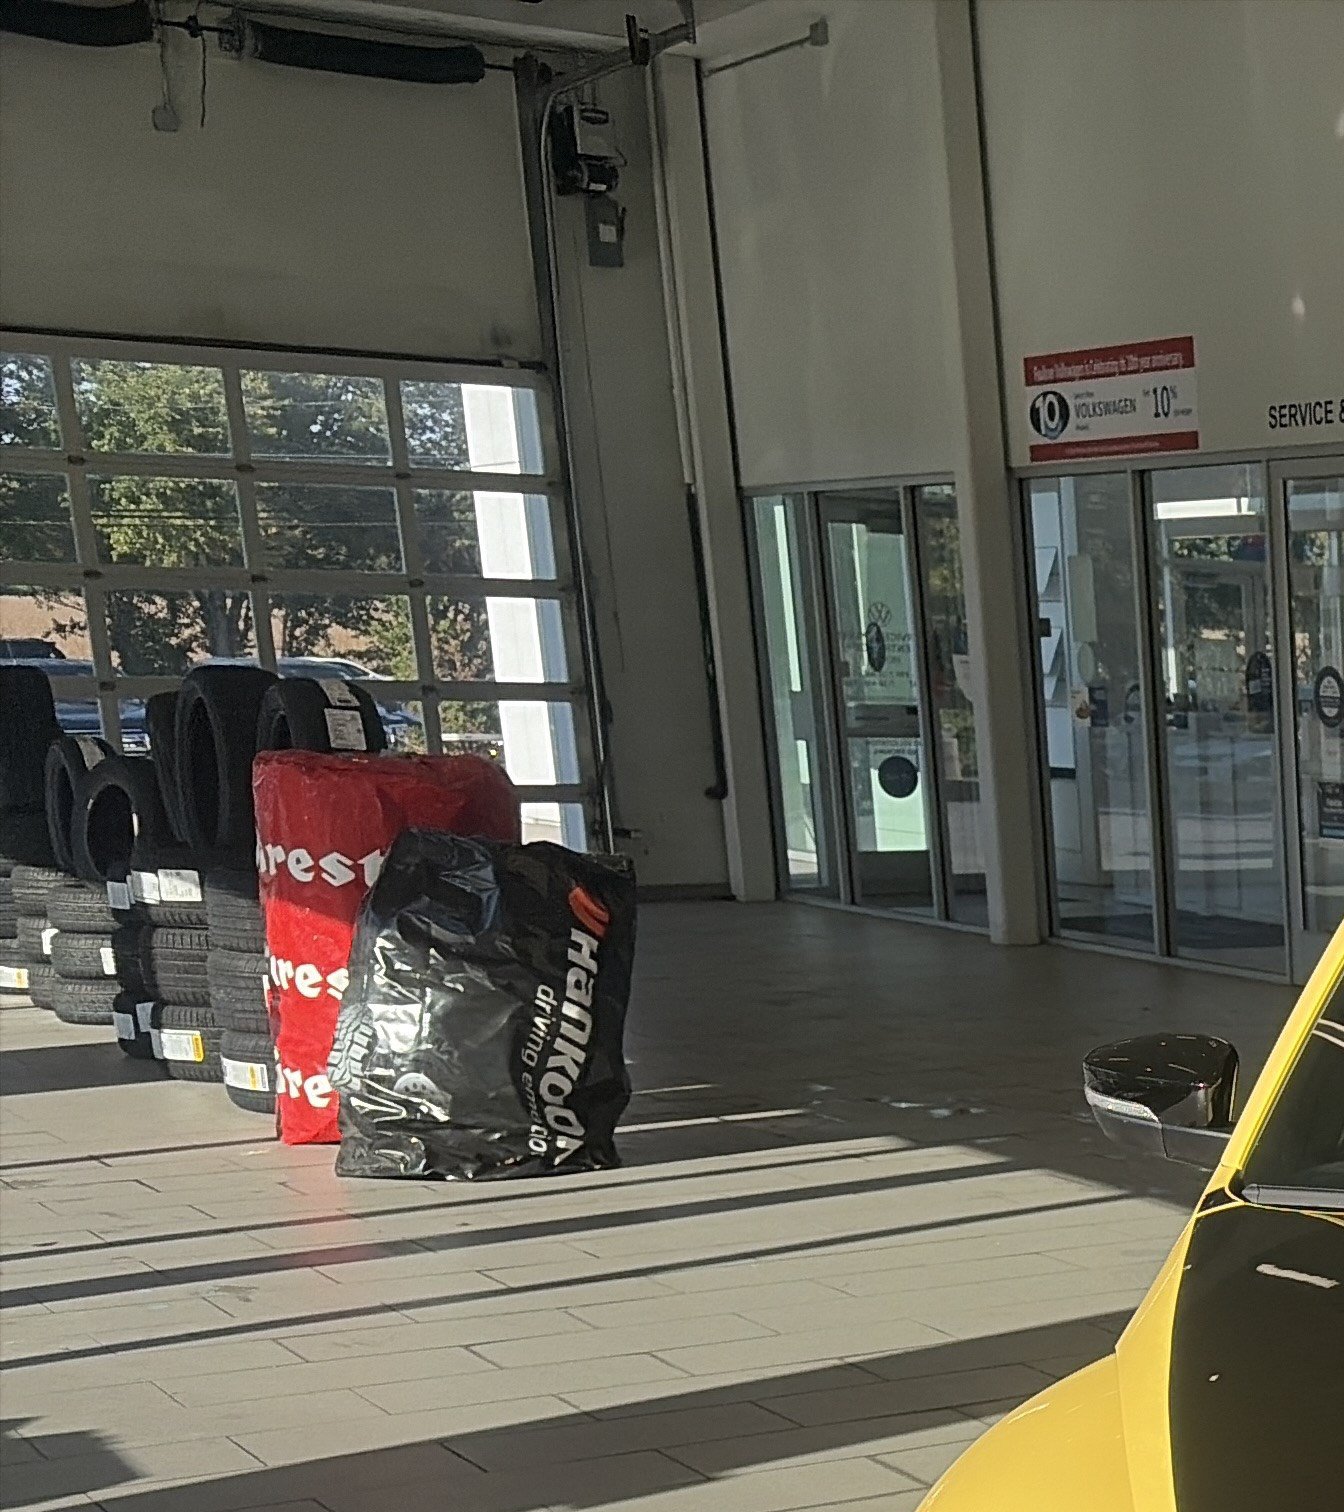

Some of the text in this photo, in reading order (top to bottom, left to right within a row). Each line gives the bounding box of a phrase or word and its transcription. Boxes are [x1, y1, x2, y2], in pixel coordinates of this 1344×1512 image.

[1034, 392, 1061, 435] 10
[1073, 397, 1137, 419] VOLKSWAGEN
[1268, 399, 1334, 430] SERVICE
[521, 984, 557, 1068] driving
